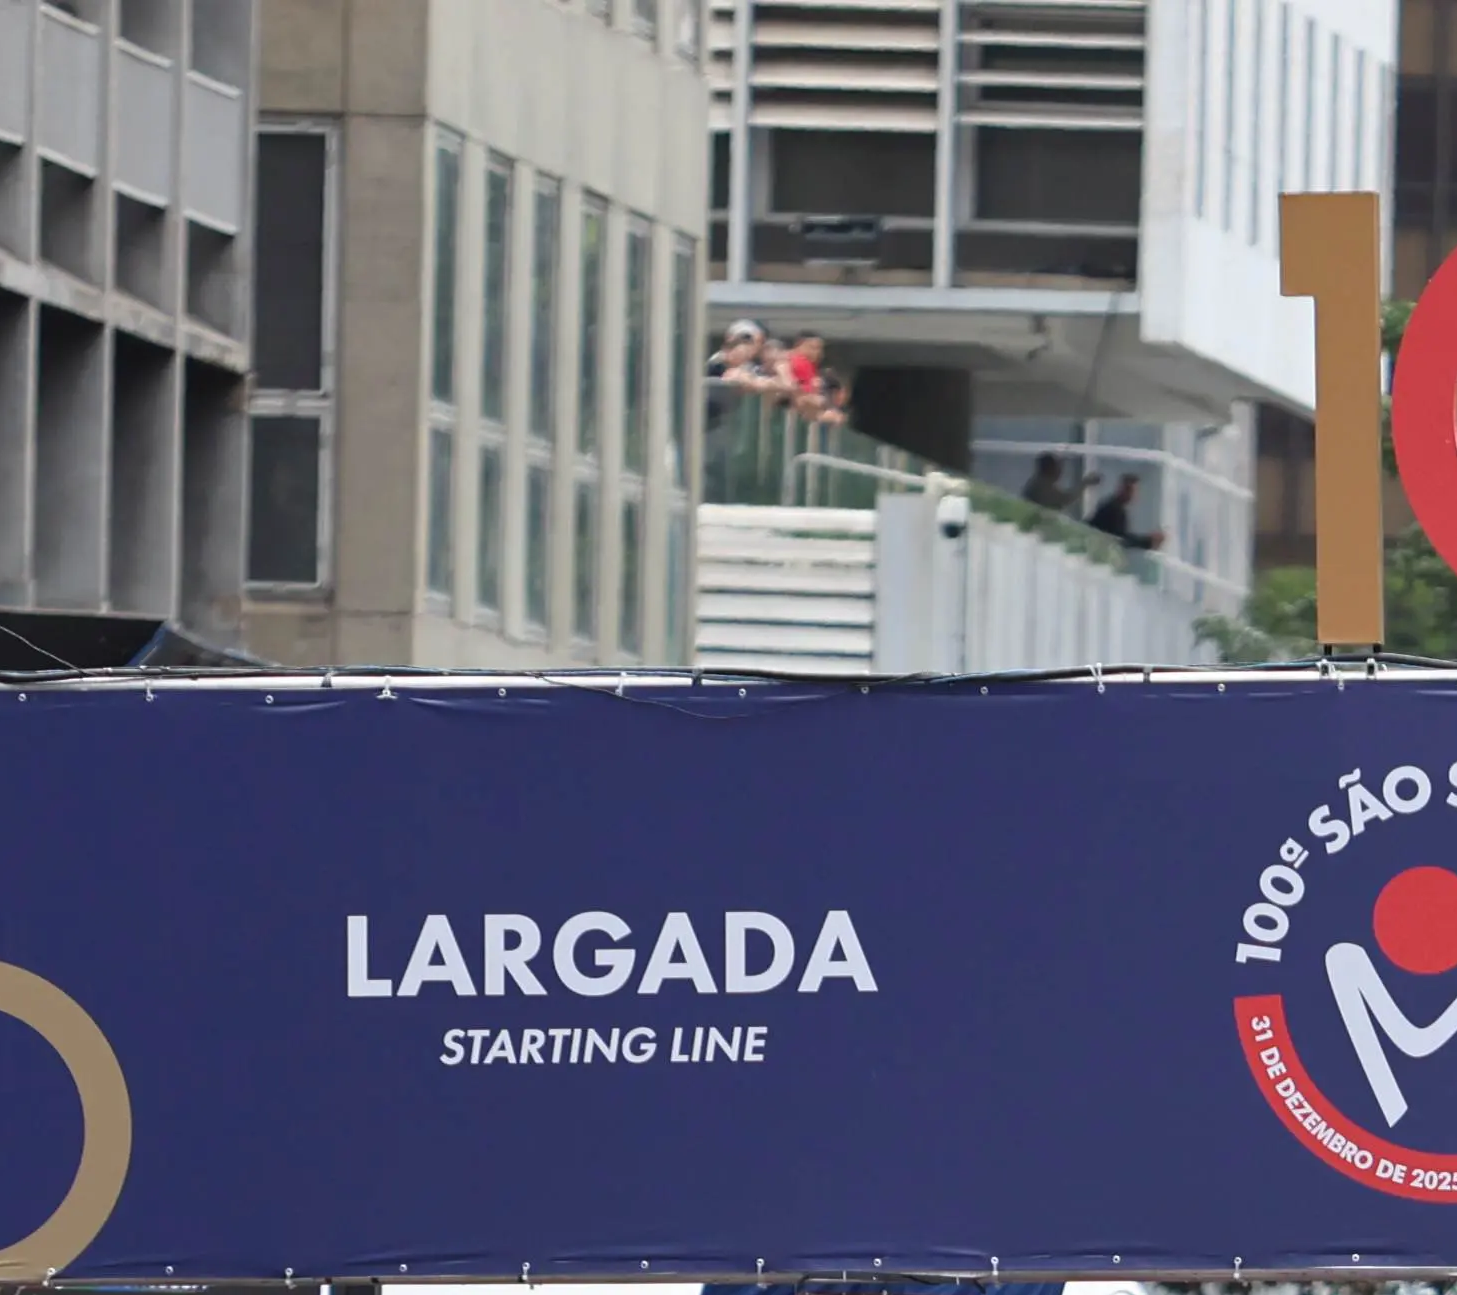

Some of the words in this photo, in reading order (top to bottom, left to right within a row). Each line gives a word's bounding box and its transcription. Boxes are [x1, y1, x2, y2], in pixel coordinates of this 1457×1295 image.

[1235, 837, 1309, 964] 100ª
[1308, 765, 1432, 855] SÃO
[347, 910, 879, 998] LARGADA
[439, 1026, 658, 1066] STARTING
[670, 1025, 769, 1063] LINE
[1251, 1015, 1273, 1042] 31
[1260, 1046, 1287, 1080] DE
[1275, 1077, 1374, 1171] DEZEMBRO
[1375, 1157, 1407, 1186] DE
